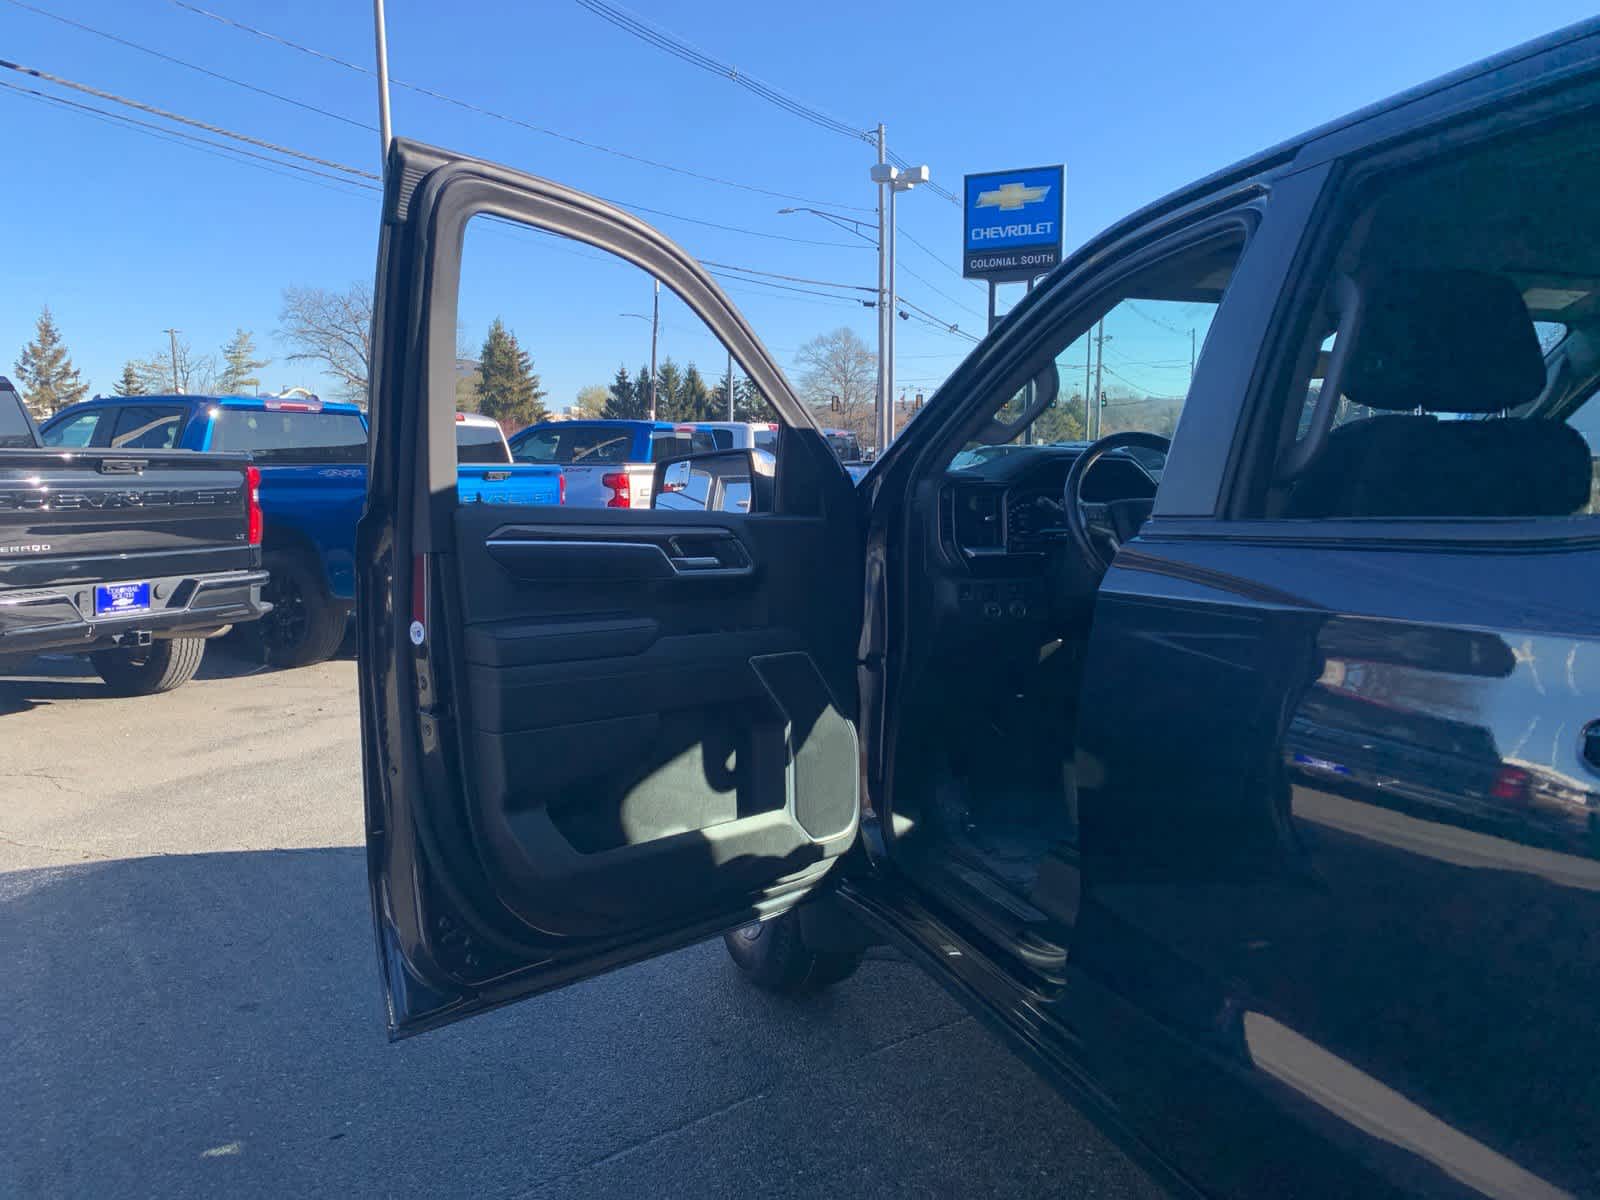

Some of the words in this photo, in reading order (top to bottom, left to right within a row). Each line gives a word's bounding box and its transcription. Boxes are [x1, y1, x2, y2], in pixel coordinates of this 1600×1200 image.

[971, 222, 1054, 240] CHEVROLET
[970, 256, 1017, 269] COLONIAL
[1020, 253, 1054, 265] SOUTH
